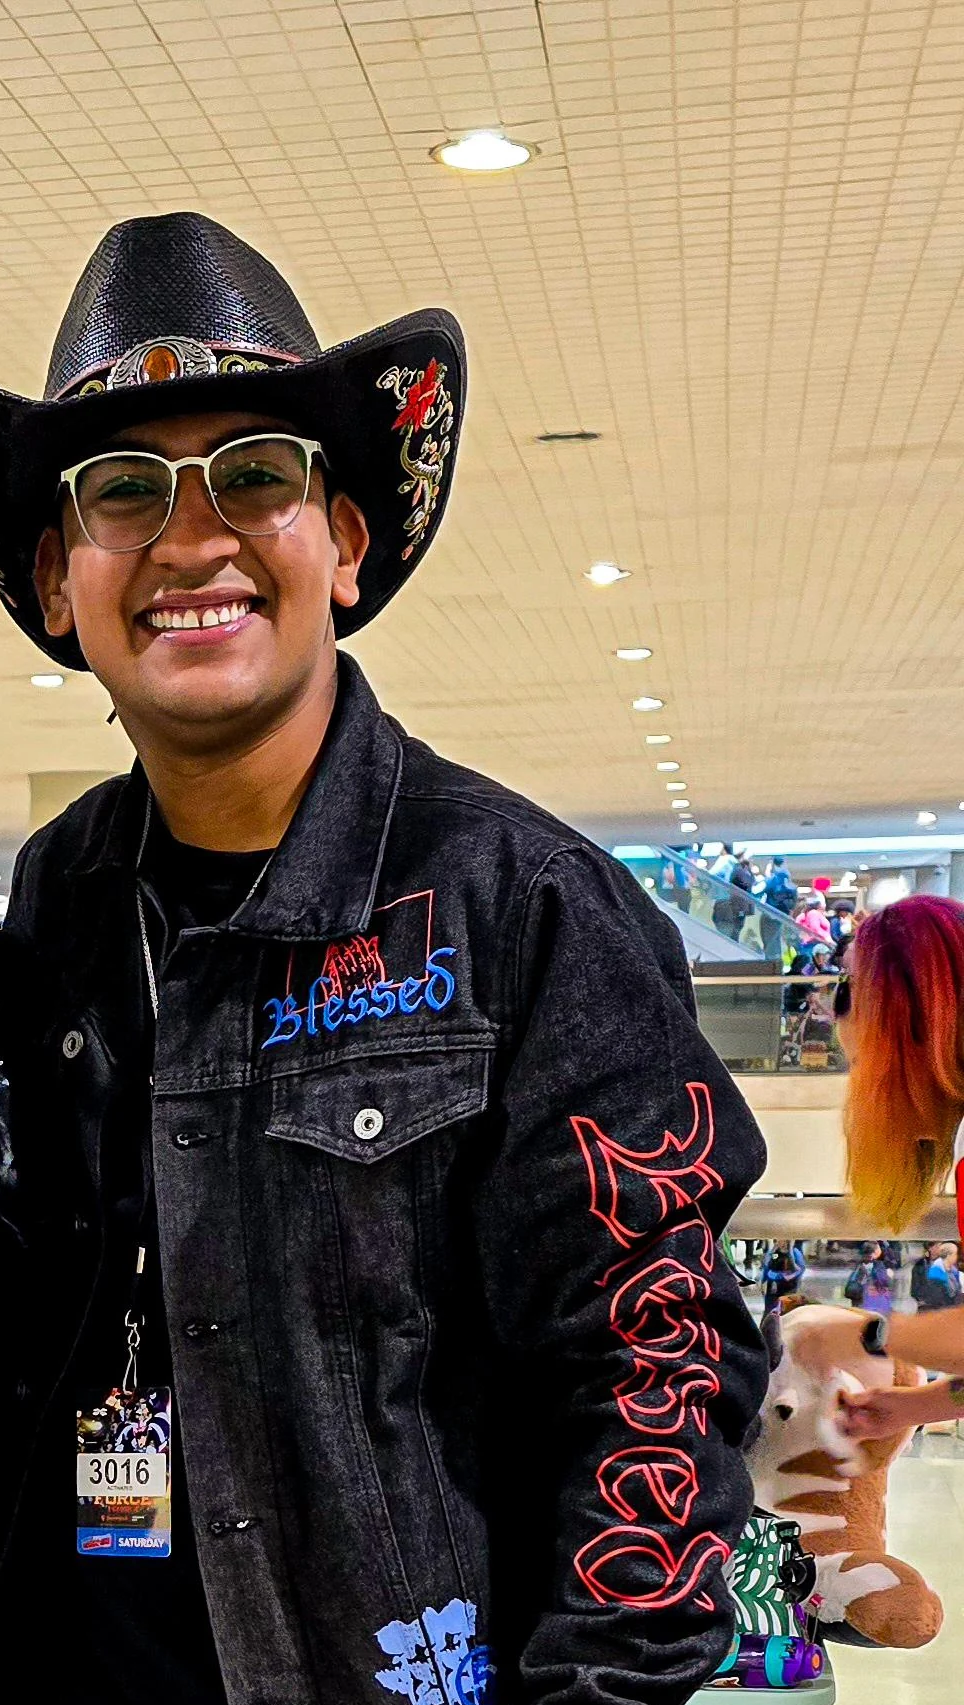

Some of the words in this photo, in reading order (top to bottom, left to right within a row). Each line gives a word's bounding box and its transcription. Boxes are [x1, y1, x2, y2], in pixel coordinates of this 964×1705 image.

[261, 947, 456, 1050] Blessed
[89, 1458, 150, 1485] 3016
[118, 1537, 165, 1548] SATURDAY
